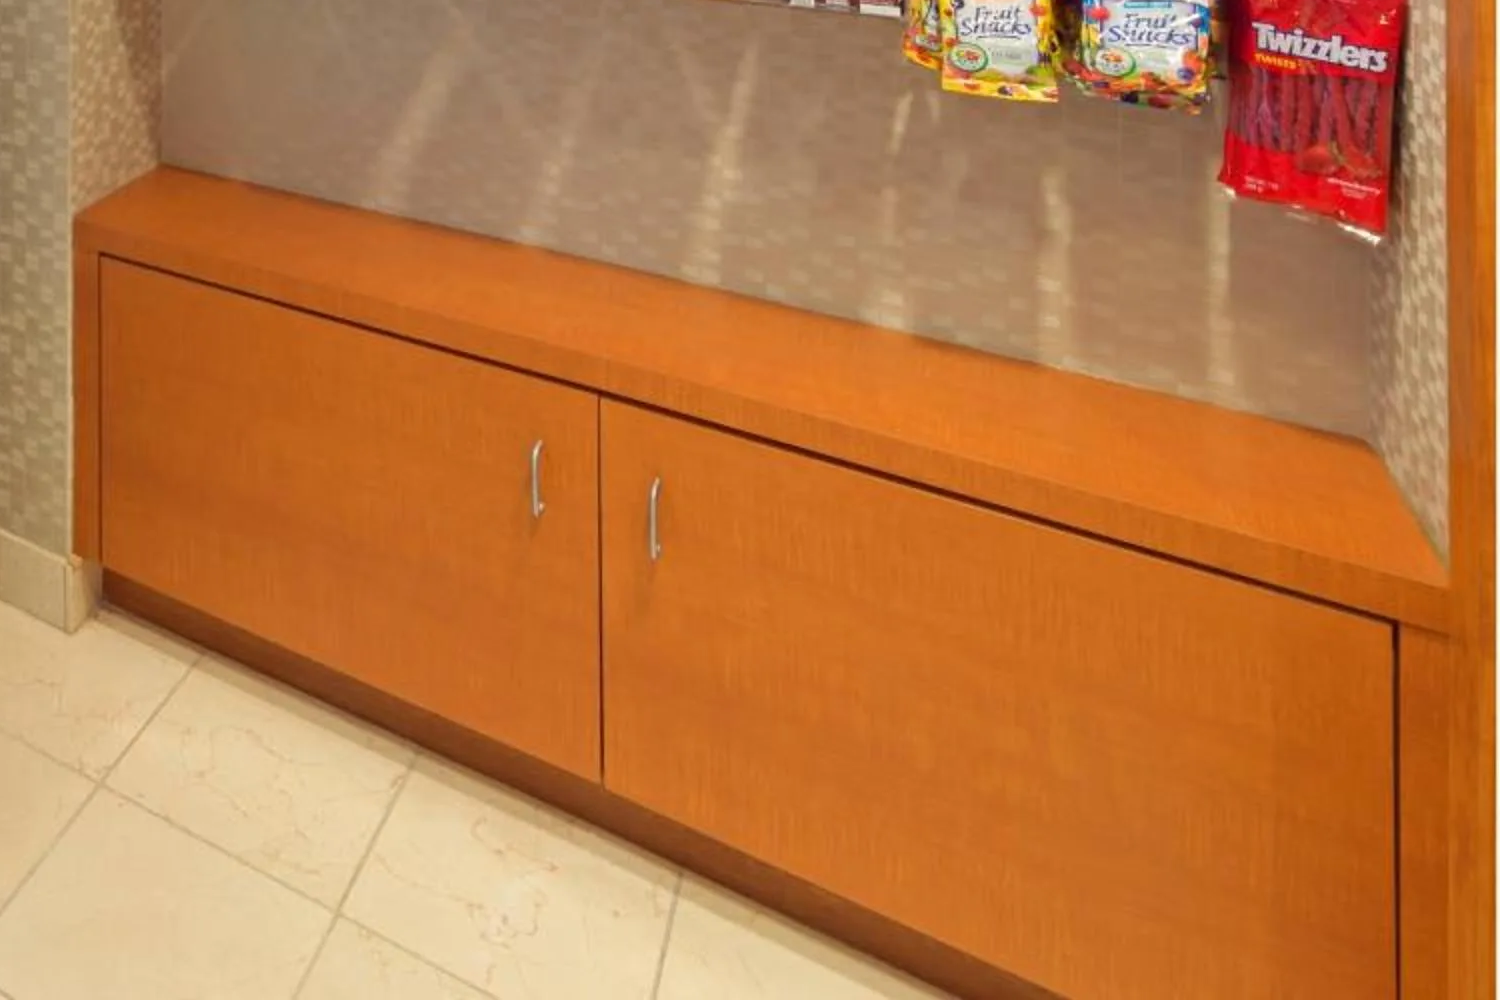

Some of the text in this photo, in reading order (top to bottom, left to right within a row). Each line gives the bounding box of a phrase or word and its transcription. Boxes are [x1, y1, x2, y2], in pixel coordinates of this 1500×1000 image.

[974, 3, 1022, 22] Fruit
[960, 17, 1032, 37] Snacks
[1251, 20, 1389, 73] Twizzlers
